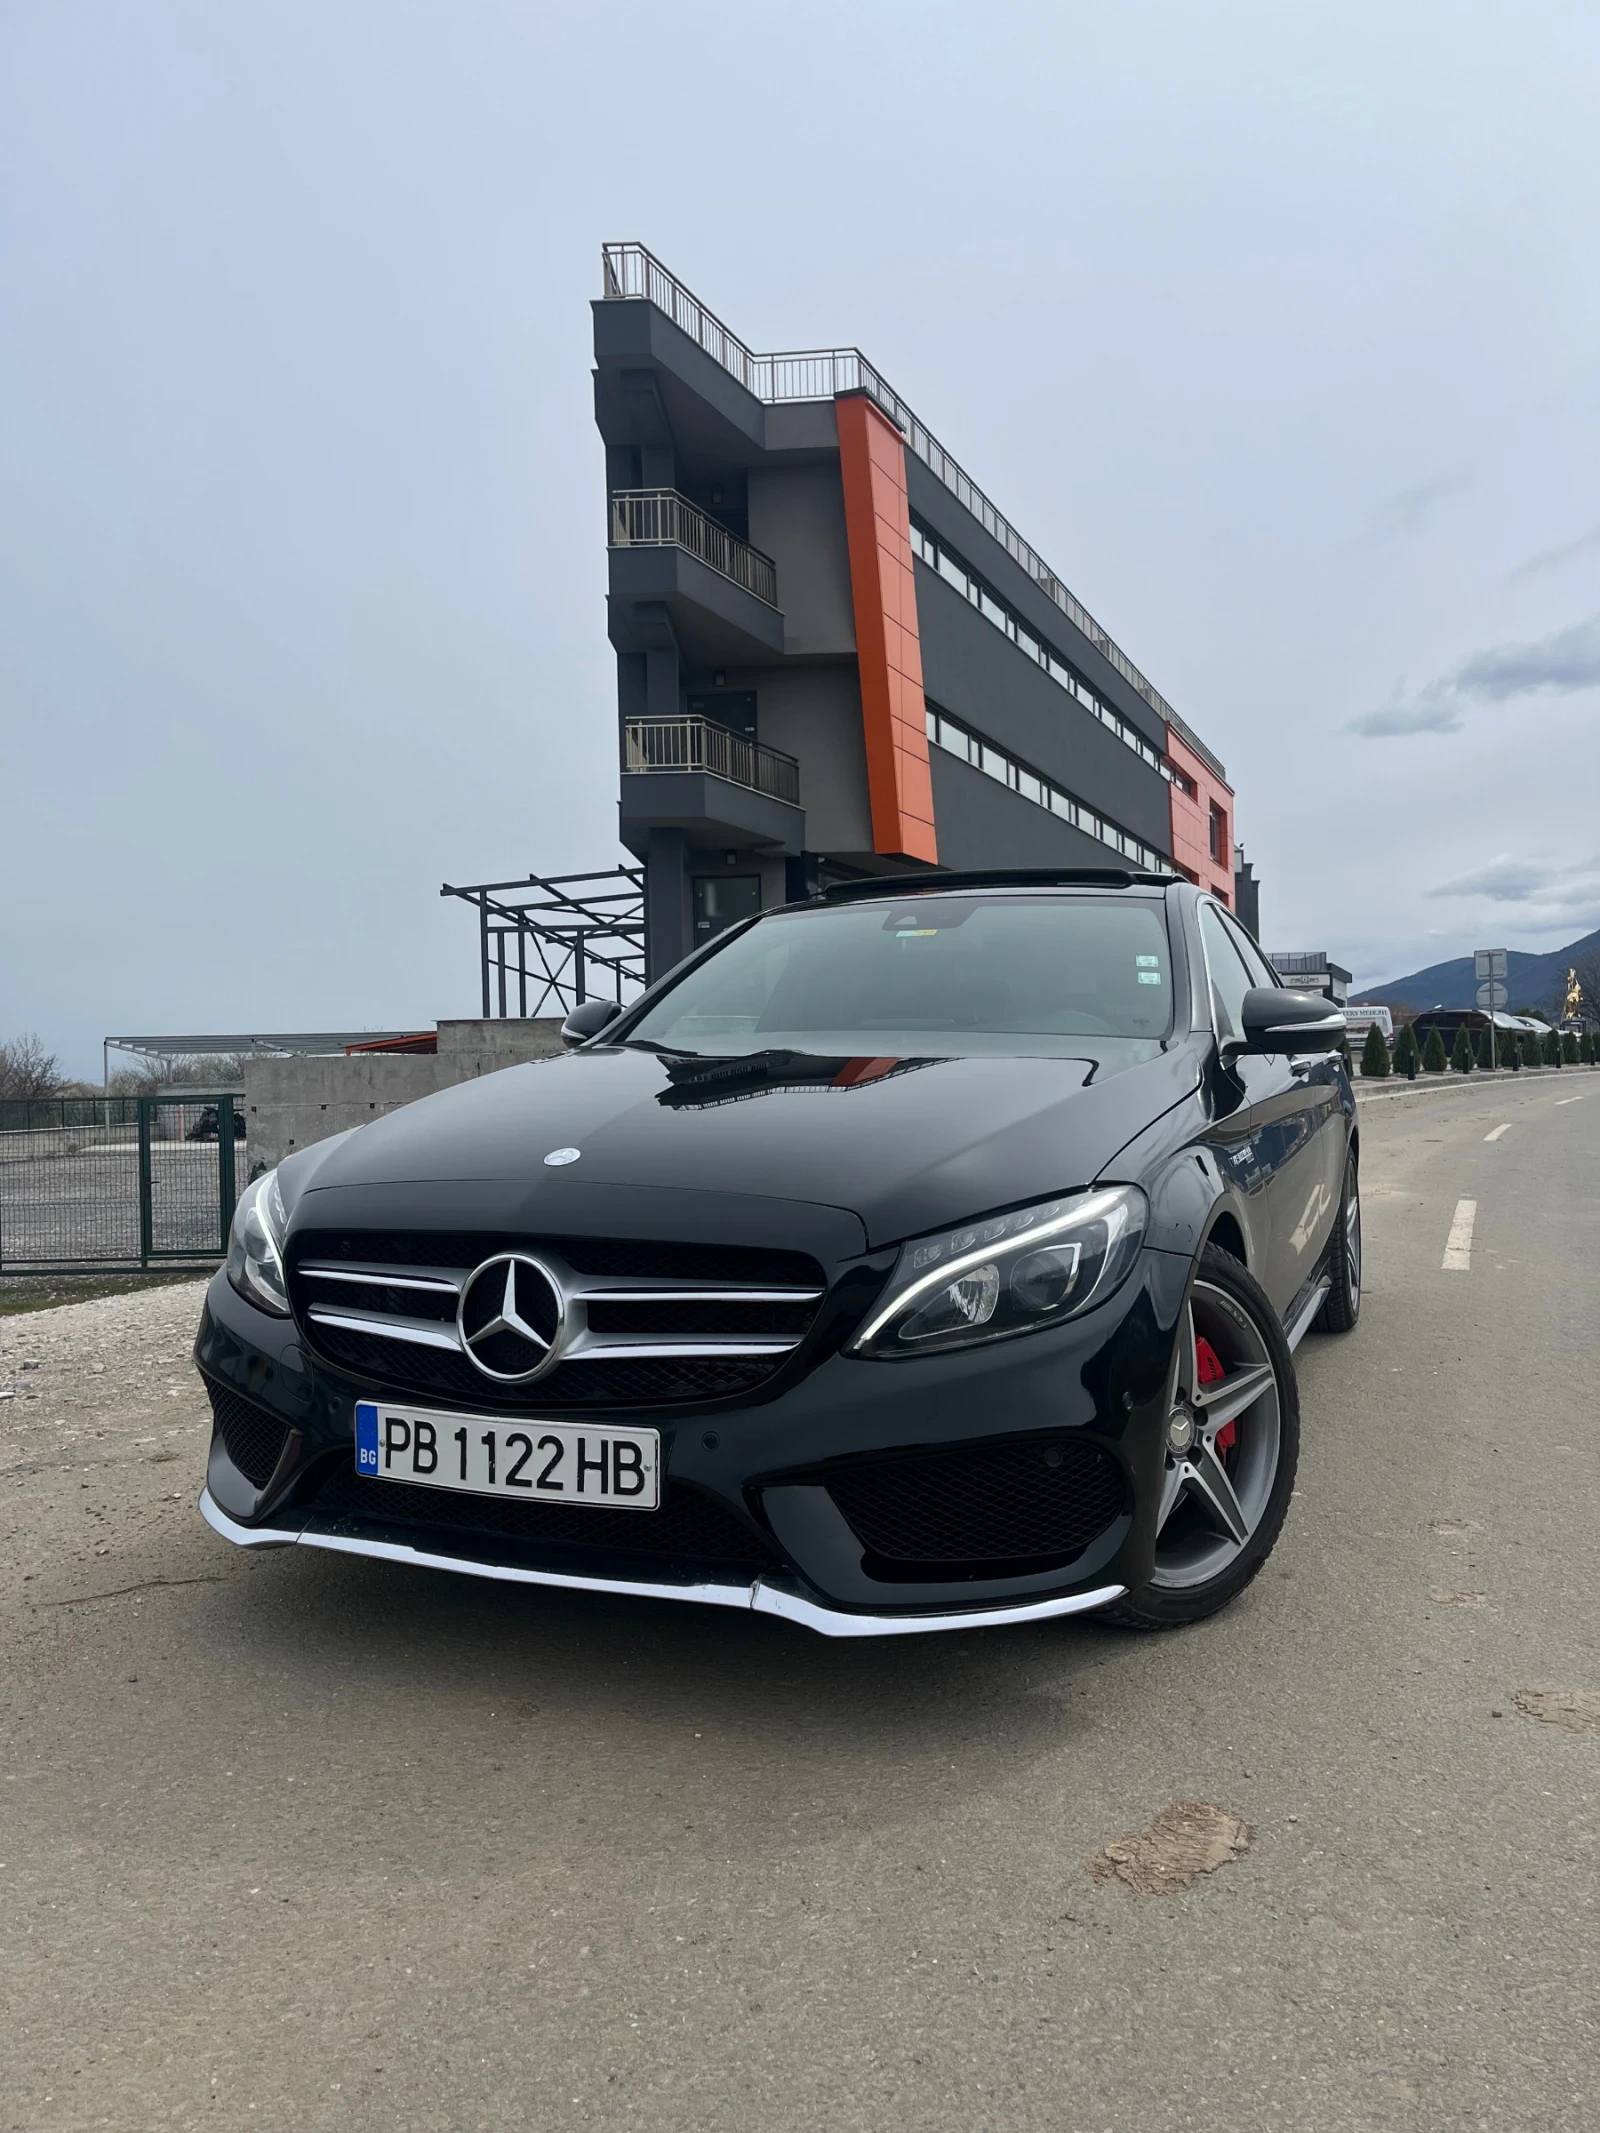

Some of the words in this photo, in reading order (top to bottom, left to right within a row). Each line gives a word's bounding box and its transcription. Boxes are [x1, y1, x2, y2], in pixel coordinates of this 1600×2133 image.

[360, 1448, 377, 1466] BG
[385, 1417, 438, 1474] PB
[454, 1427, 564, 1491] 1122
[577, 1437, 645, 1496] HB
